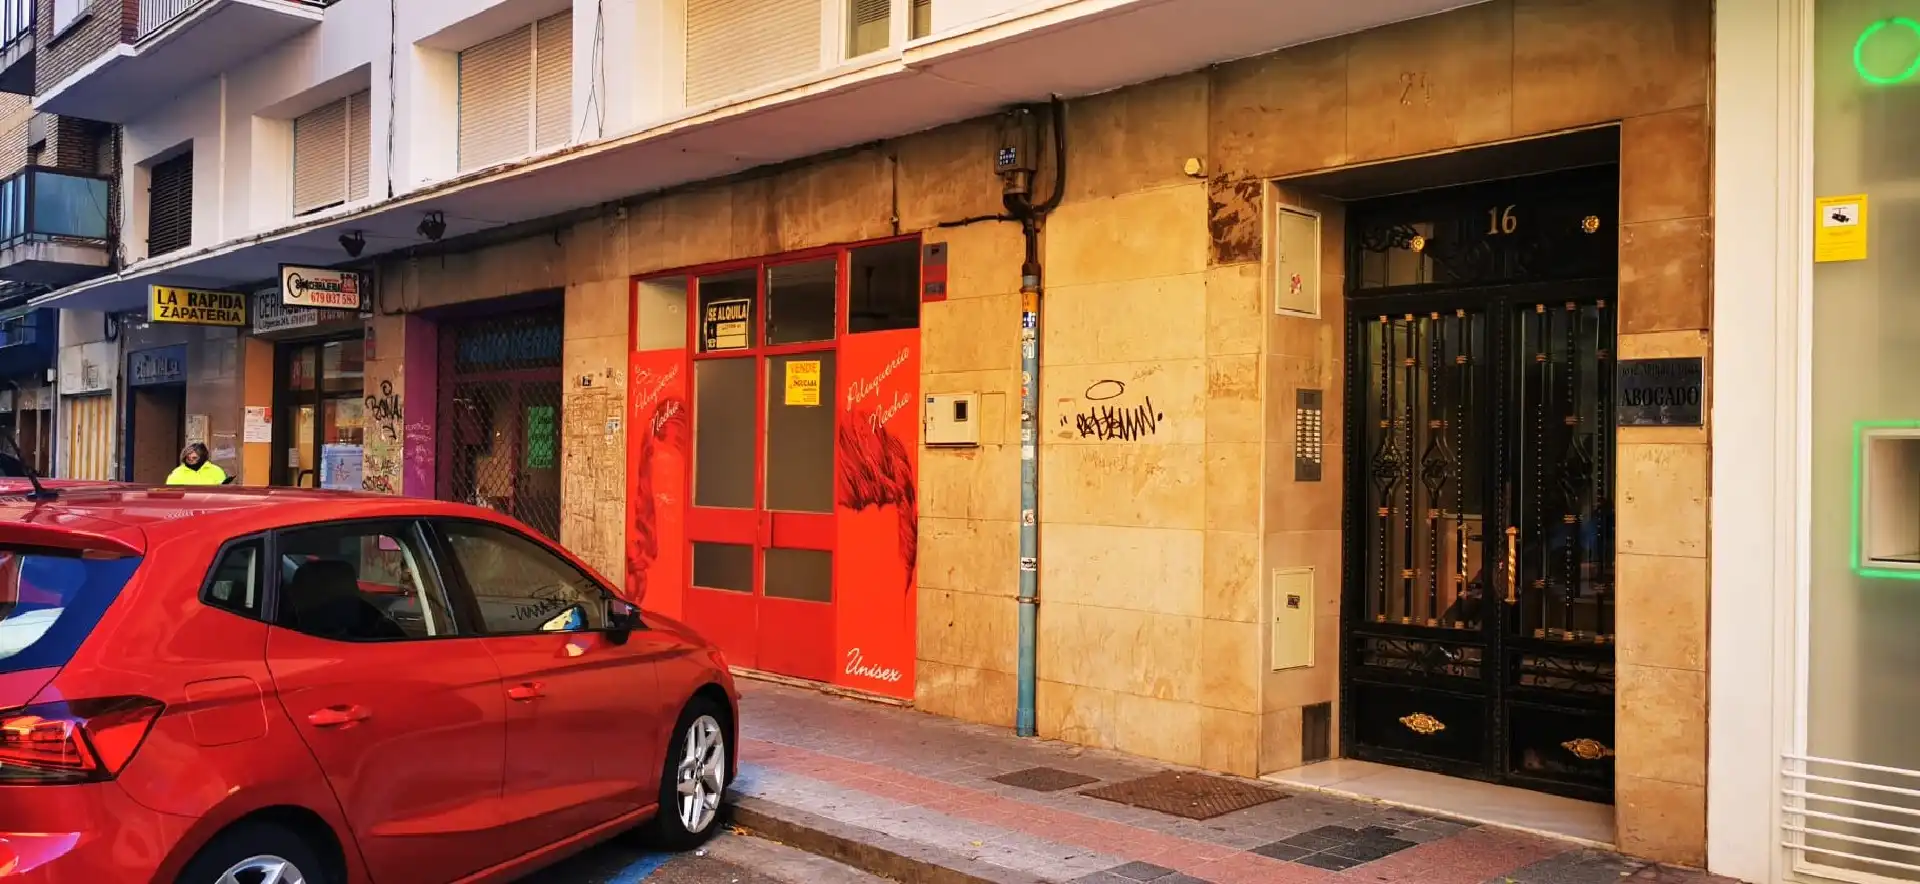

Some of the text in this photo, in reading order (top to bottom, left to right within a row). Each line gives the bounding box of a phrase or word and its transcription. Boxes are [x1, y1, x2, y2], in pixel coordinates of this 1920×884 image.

[1484, 204, 1517, 235] 16
[157, 289, 178, 306] LA
[187, 292, 244, 310] RAPIDA
[311, 291, 325, 304] 679
[326, 293, 341, 305] 037
[160, 306, 242, 323] ZAPATERIA
[708, 303, 747, 322] SE ALQUILA
[1622, 385, 1700, 407] ABOGADO
[845, 647, 903, 682] Unisex
